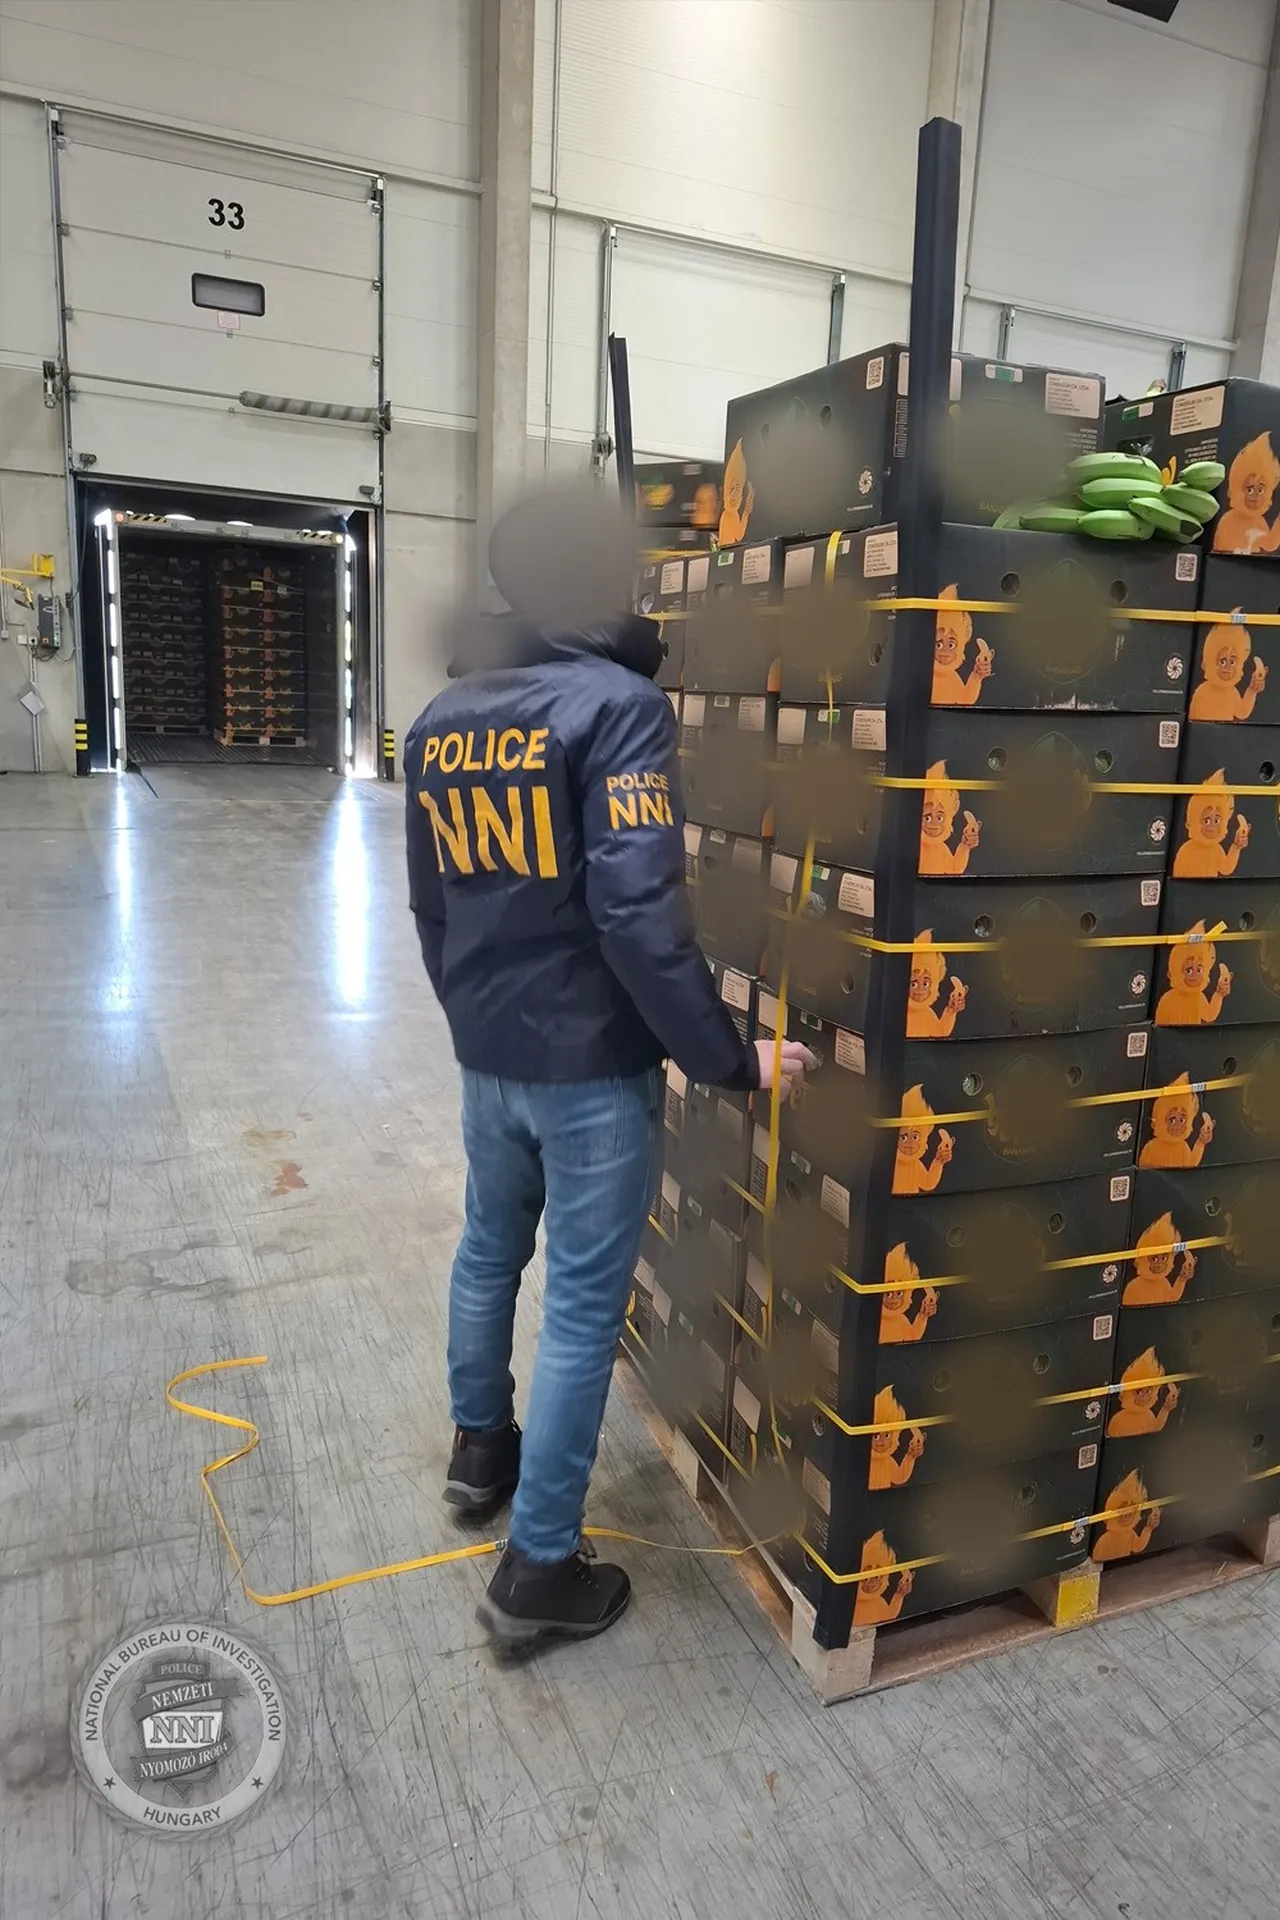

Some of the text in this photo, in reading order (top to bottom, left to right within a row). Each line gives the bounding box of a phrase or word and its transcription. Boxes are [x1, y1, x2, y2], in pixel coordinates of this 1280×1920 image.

[208, 198, 245, 230] 33
[422, 728, 549, 777] POLICE
[606, 772, 669, 793] POLICE
[608, 793, 674, 831] NNI
[418, 786, 558, 879] NNI
